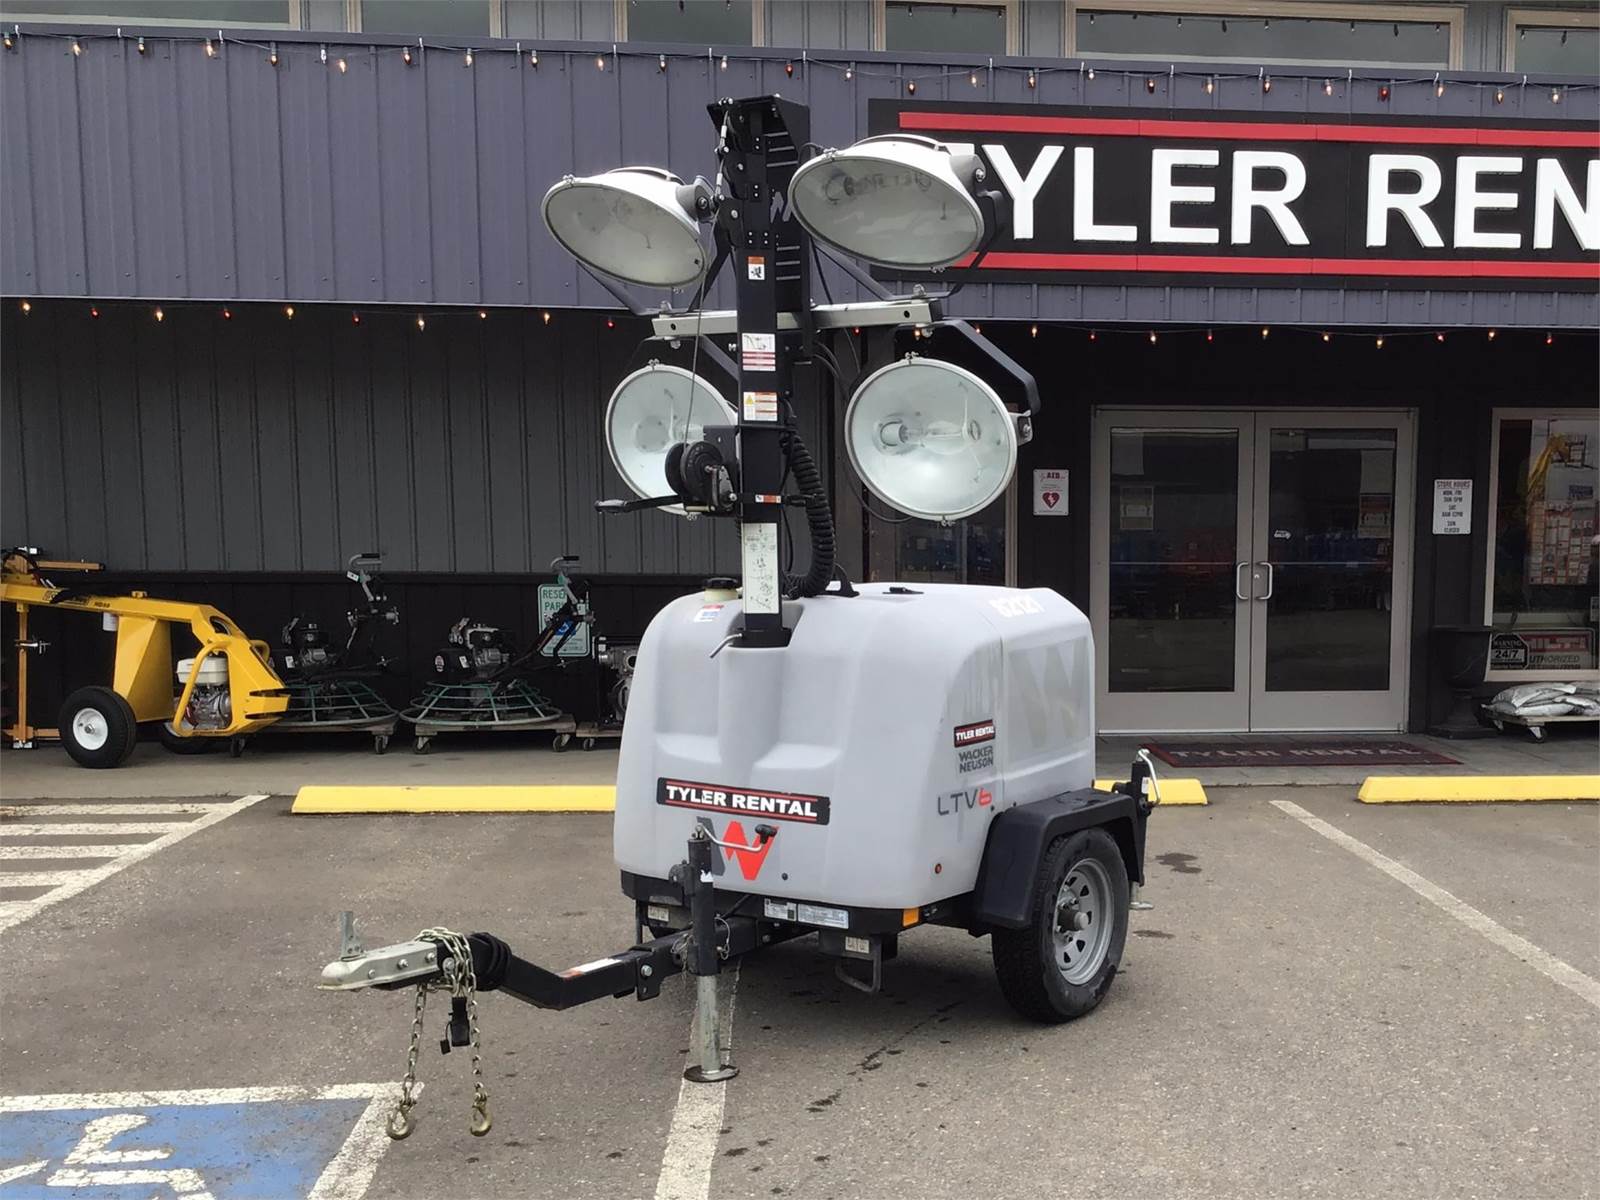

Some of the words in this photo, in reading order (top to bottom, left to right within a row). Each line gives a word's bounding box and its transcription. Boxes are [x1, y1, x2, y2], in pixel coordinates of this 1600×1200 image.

[942, 142, 1311, 246] YLER
[1365, 153, 1600, 250] REN
[1495, 650, 1519, 659] 24/7
[959, 745, 993, 762] WACKER
[959, 757, 993, 773] NEUSON
[666, 785, 726, 807] TYLER
[732, 793, 817, 817] RENTAL
[937, 787, 992, 816] LTV6
